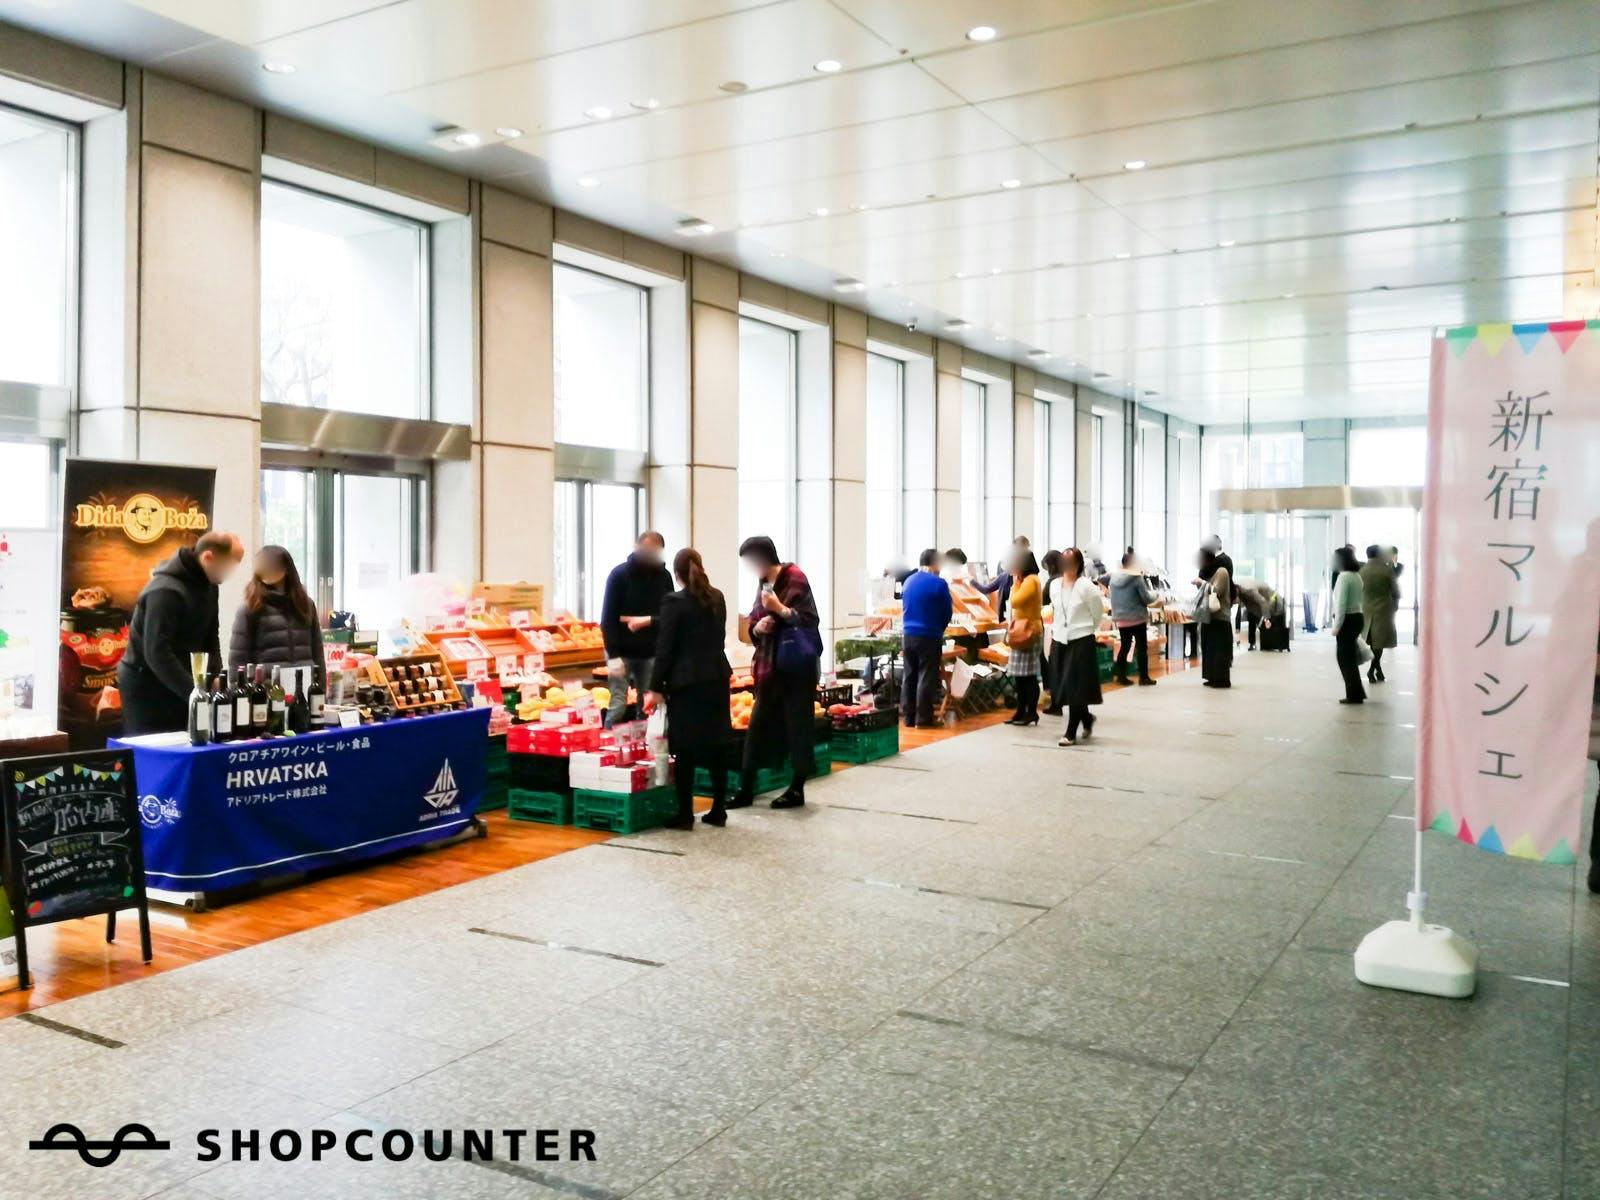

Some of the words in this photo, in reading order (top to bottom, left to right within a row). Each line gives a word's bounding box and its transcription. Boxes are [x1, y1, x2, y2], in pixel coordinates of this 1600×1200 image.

[76, 504, 123, 526] Dida
[163, 506, 207, 528] Boža
[1475, 389, 1554, 780] 新宿マルシェ
[225, 760, 328, 789] HRVATSKA
[226, 784, 328, 808] アドリアトレード株式会社
